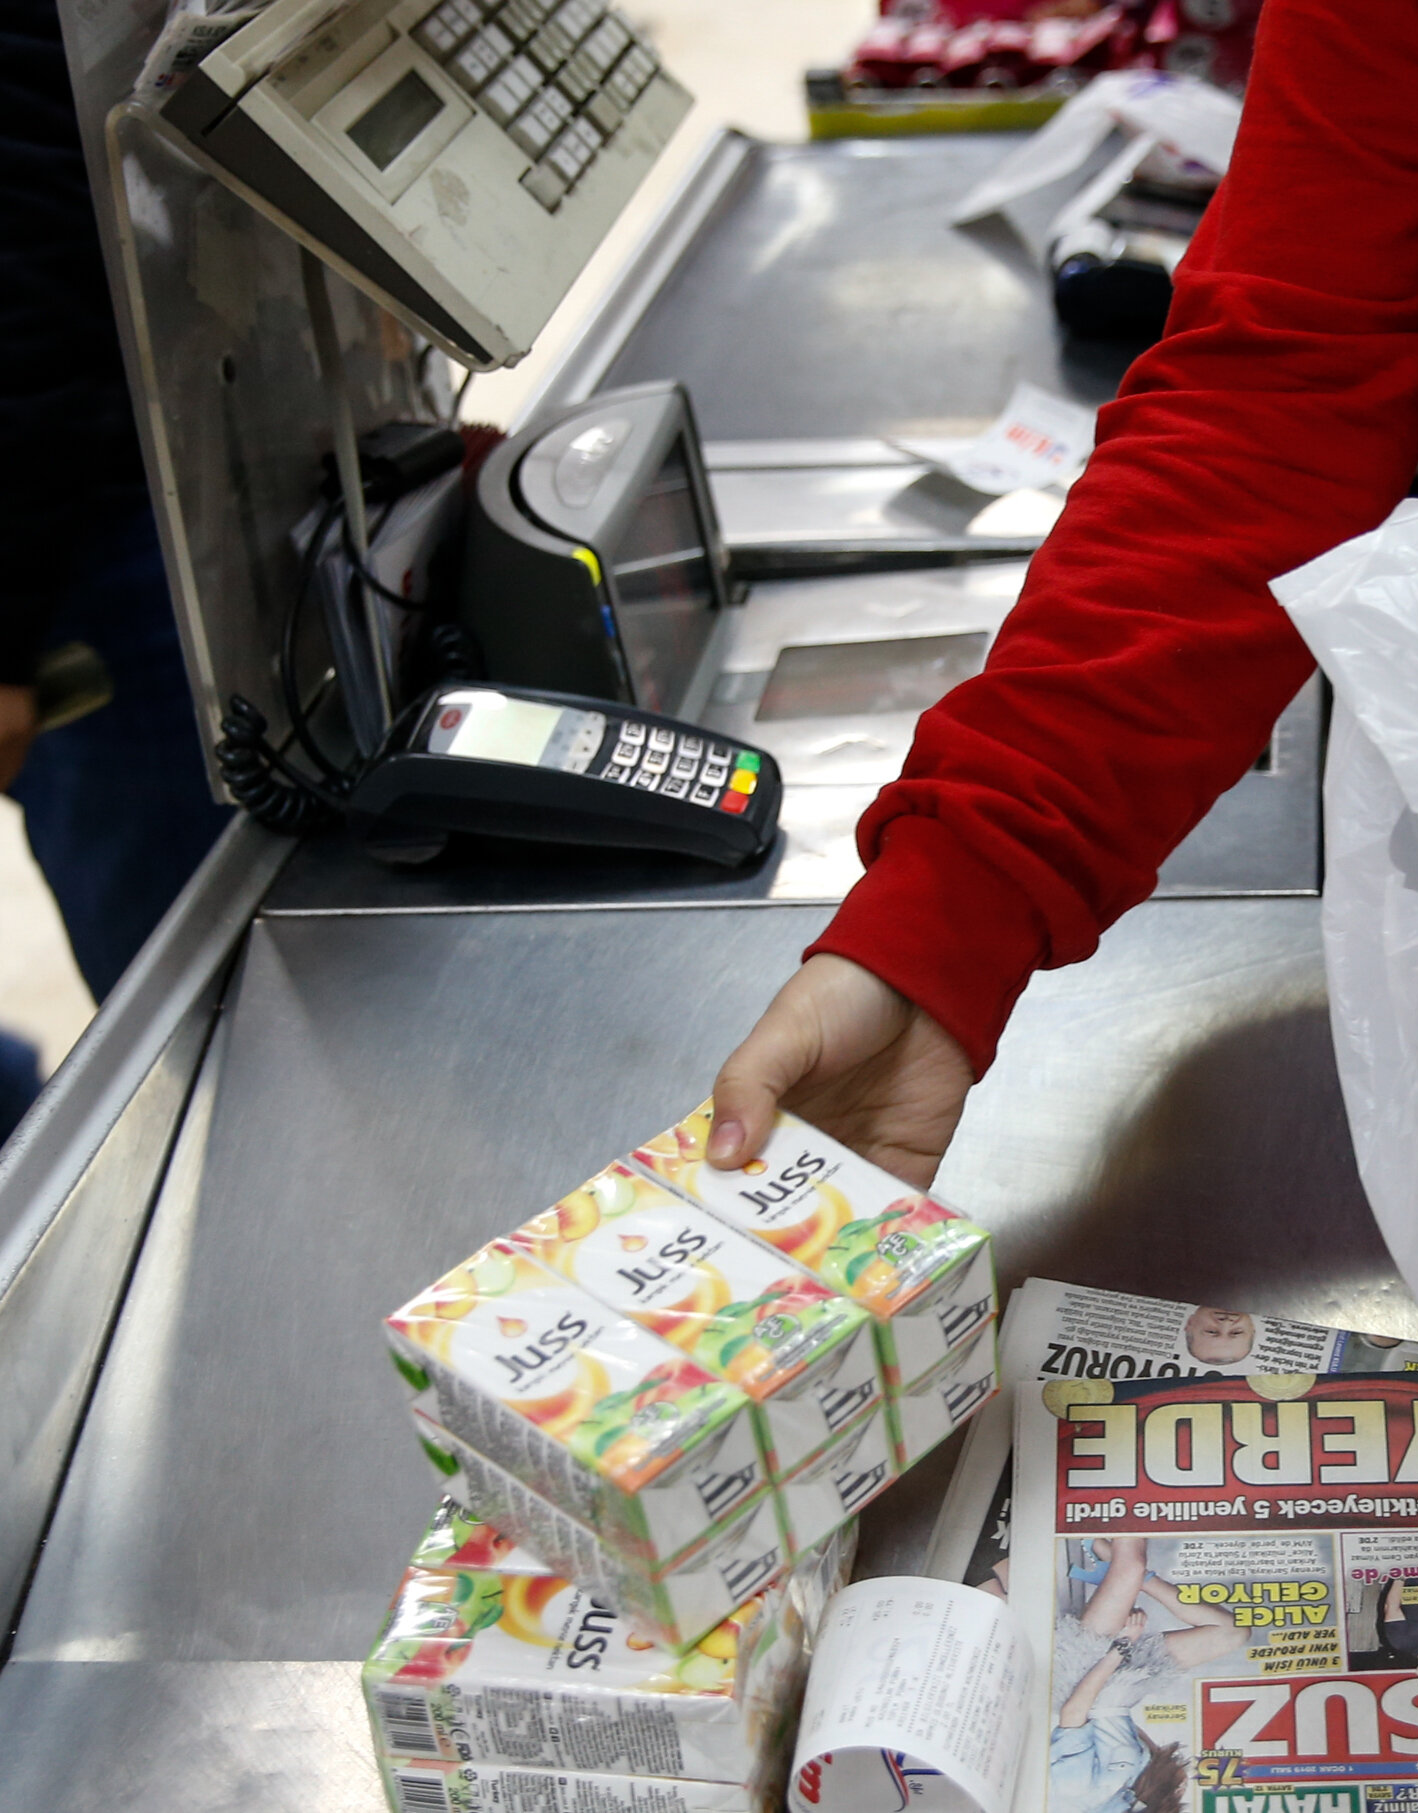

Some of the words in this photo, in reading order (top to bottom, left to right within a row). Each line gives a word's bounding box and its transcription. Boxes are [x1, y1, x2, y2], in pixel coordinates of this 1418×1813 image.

[1066, 1498, 1126, 1522] girdi
[1133, 1497, 1246, 1521] yenilikle
[1254, 1500, 1270, 1518] 5
[1314, 1629, 1336, 1639] YER
[1249, 1644, 1306, 1658] PROJEDE
[1310, 1642, 1338, 1653] AYNI
[1296, 1657, 1328, 1669] ÜNLÜ
[1332, 1656, 1340, 1665] 3
[1197, 1757, 1244, 1787] 75
